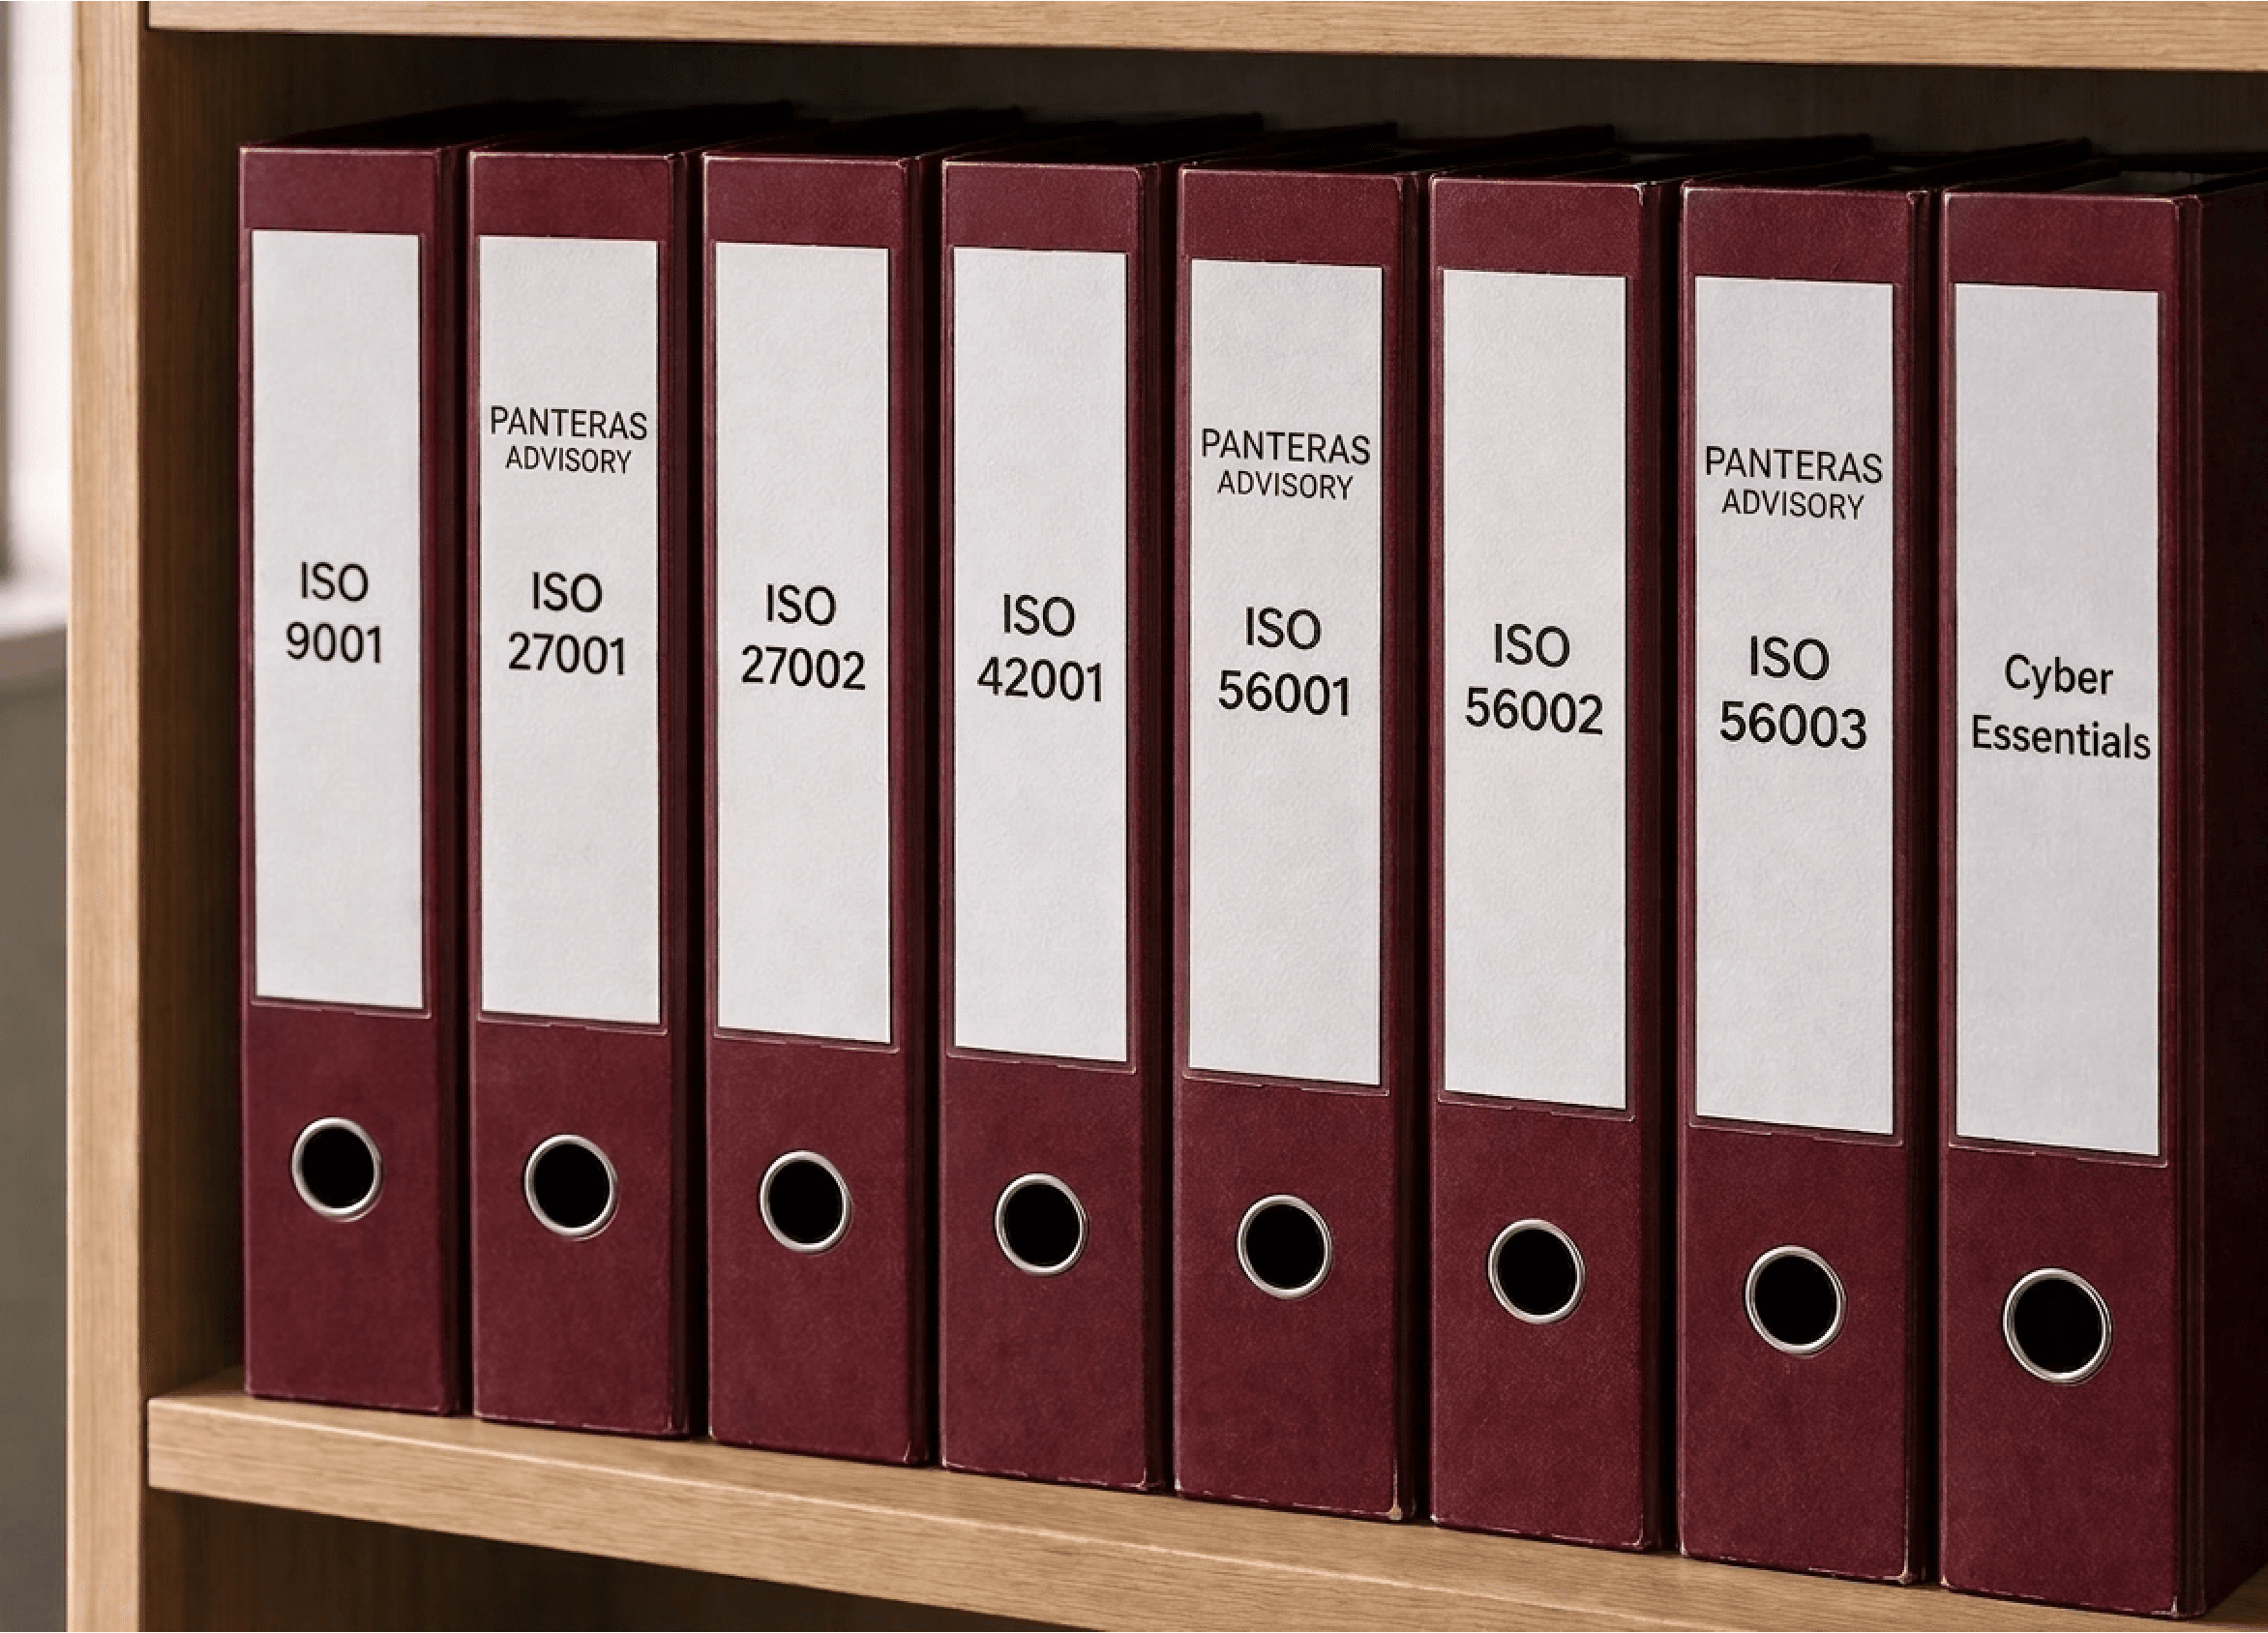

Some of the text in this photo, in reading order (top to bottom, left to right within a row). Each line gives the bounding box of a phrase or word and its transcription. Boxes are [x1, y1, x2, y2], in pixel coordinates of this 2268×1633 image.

[491, 404, 647, 441] PANTERAS
[504, 445, 632, 474] ADVISORY
[1201, 428, 1371, 466] PANTERAS
[1706, 445, 1884, 484] PANTERAS
[1216, 468, 1354, 501] ADVISORY
[1721, 488, 1865, 520] ADVISORY
[301, 561, 369, 604] ISO
[533, 571, 603, 613] ISO
[767, 582, 837, 627] ISO
[1003, 594, 1075, 638] ISO
[1245, 606, 1323, 650] ISO
[285, 621, 380, 664] 9001
[508, 631, 624, 675] 27001
[1495, 623, 1570, 668] ISO
[1750, 635, 1830, 681] ISO
[740, 644, 866, 691] 27002
[976, 656, 1102, 702] 42001
[2004, 652, 2114, 700] Cyber
[1218, 669, 1350, 718] 56001
[1464, 685, 1603, 735] 56002
[1719, 700, 1868, 751] 56003
[1973, 714, 2151, 760] Essentials
